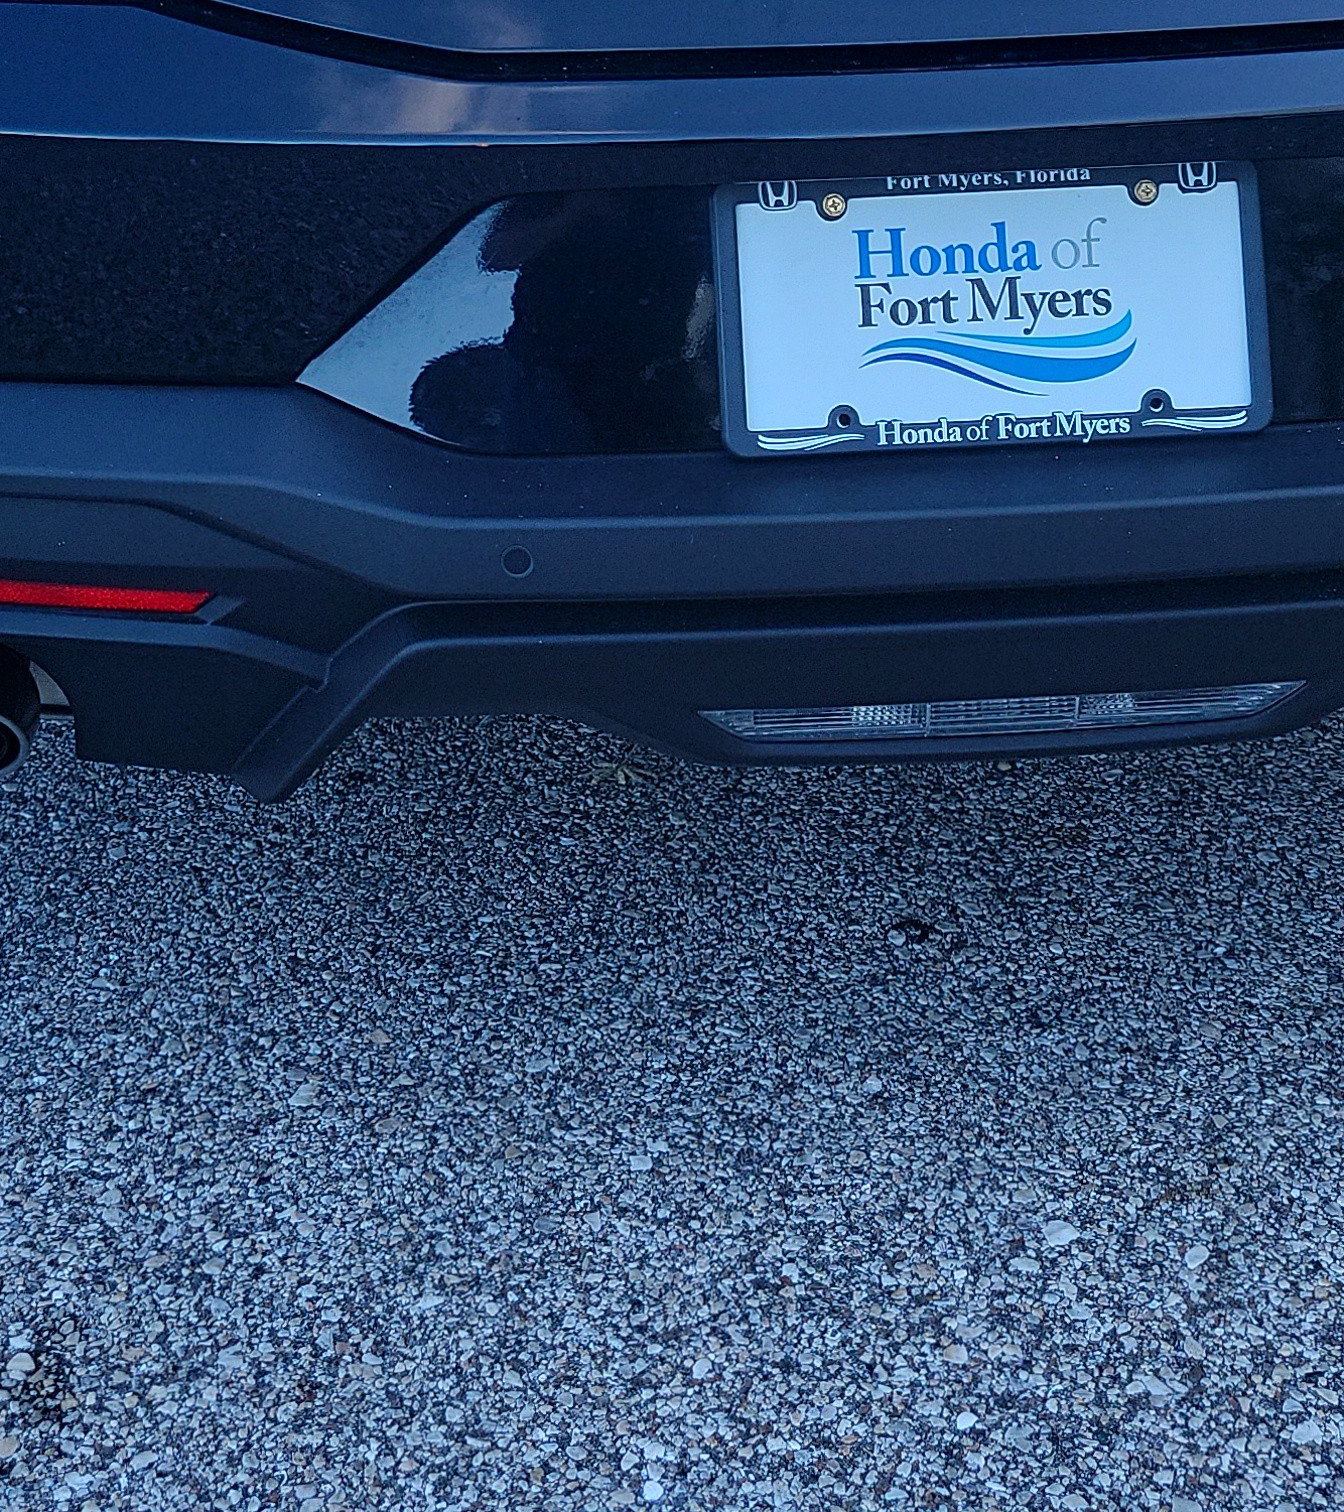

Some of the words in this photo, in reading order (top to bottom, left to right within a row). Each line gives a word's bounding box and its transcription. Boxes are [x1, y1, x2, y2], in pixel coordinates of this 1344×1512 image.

[887, 175, 931, 190] Fort
[938, 171, 1010, 191] Myers,
[1016, 168, 1091, 183] Florida
[851, 220, 1043, 280] Honda
[1050, 217, 1108, 270] of
[854, 282, 959, 328] Fort
[965, 275, 1113, 336] Myers
[876, 418, 963, 446] Honda
[965, 415, 993, 441] of
[996, 414, 1052, 440] Fort
[1053, 411, 1131, 443] Myers
